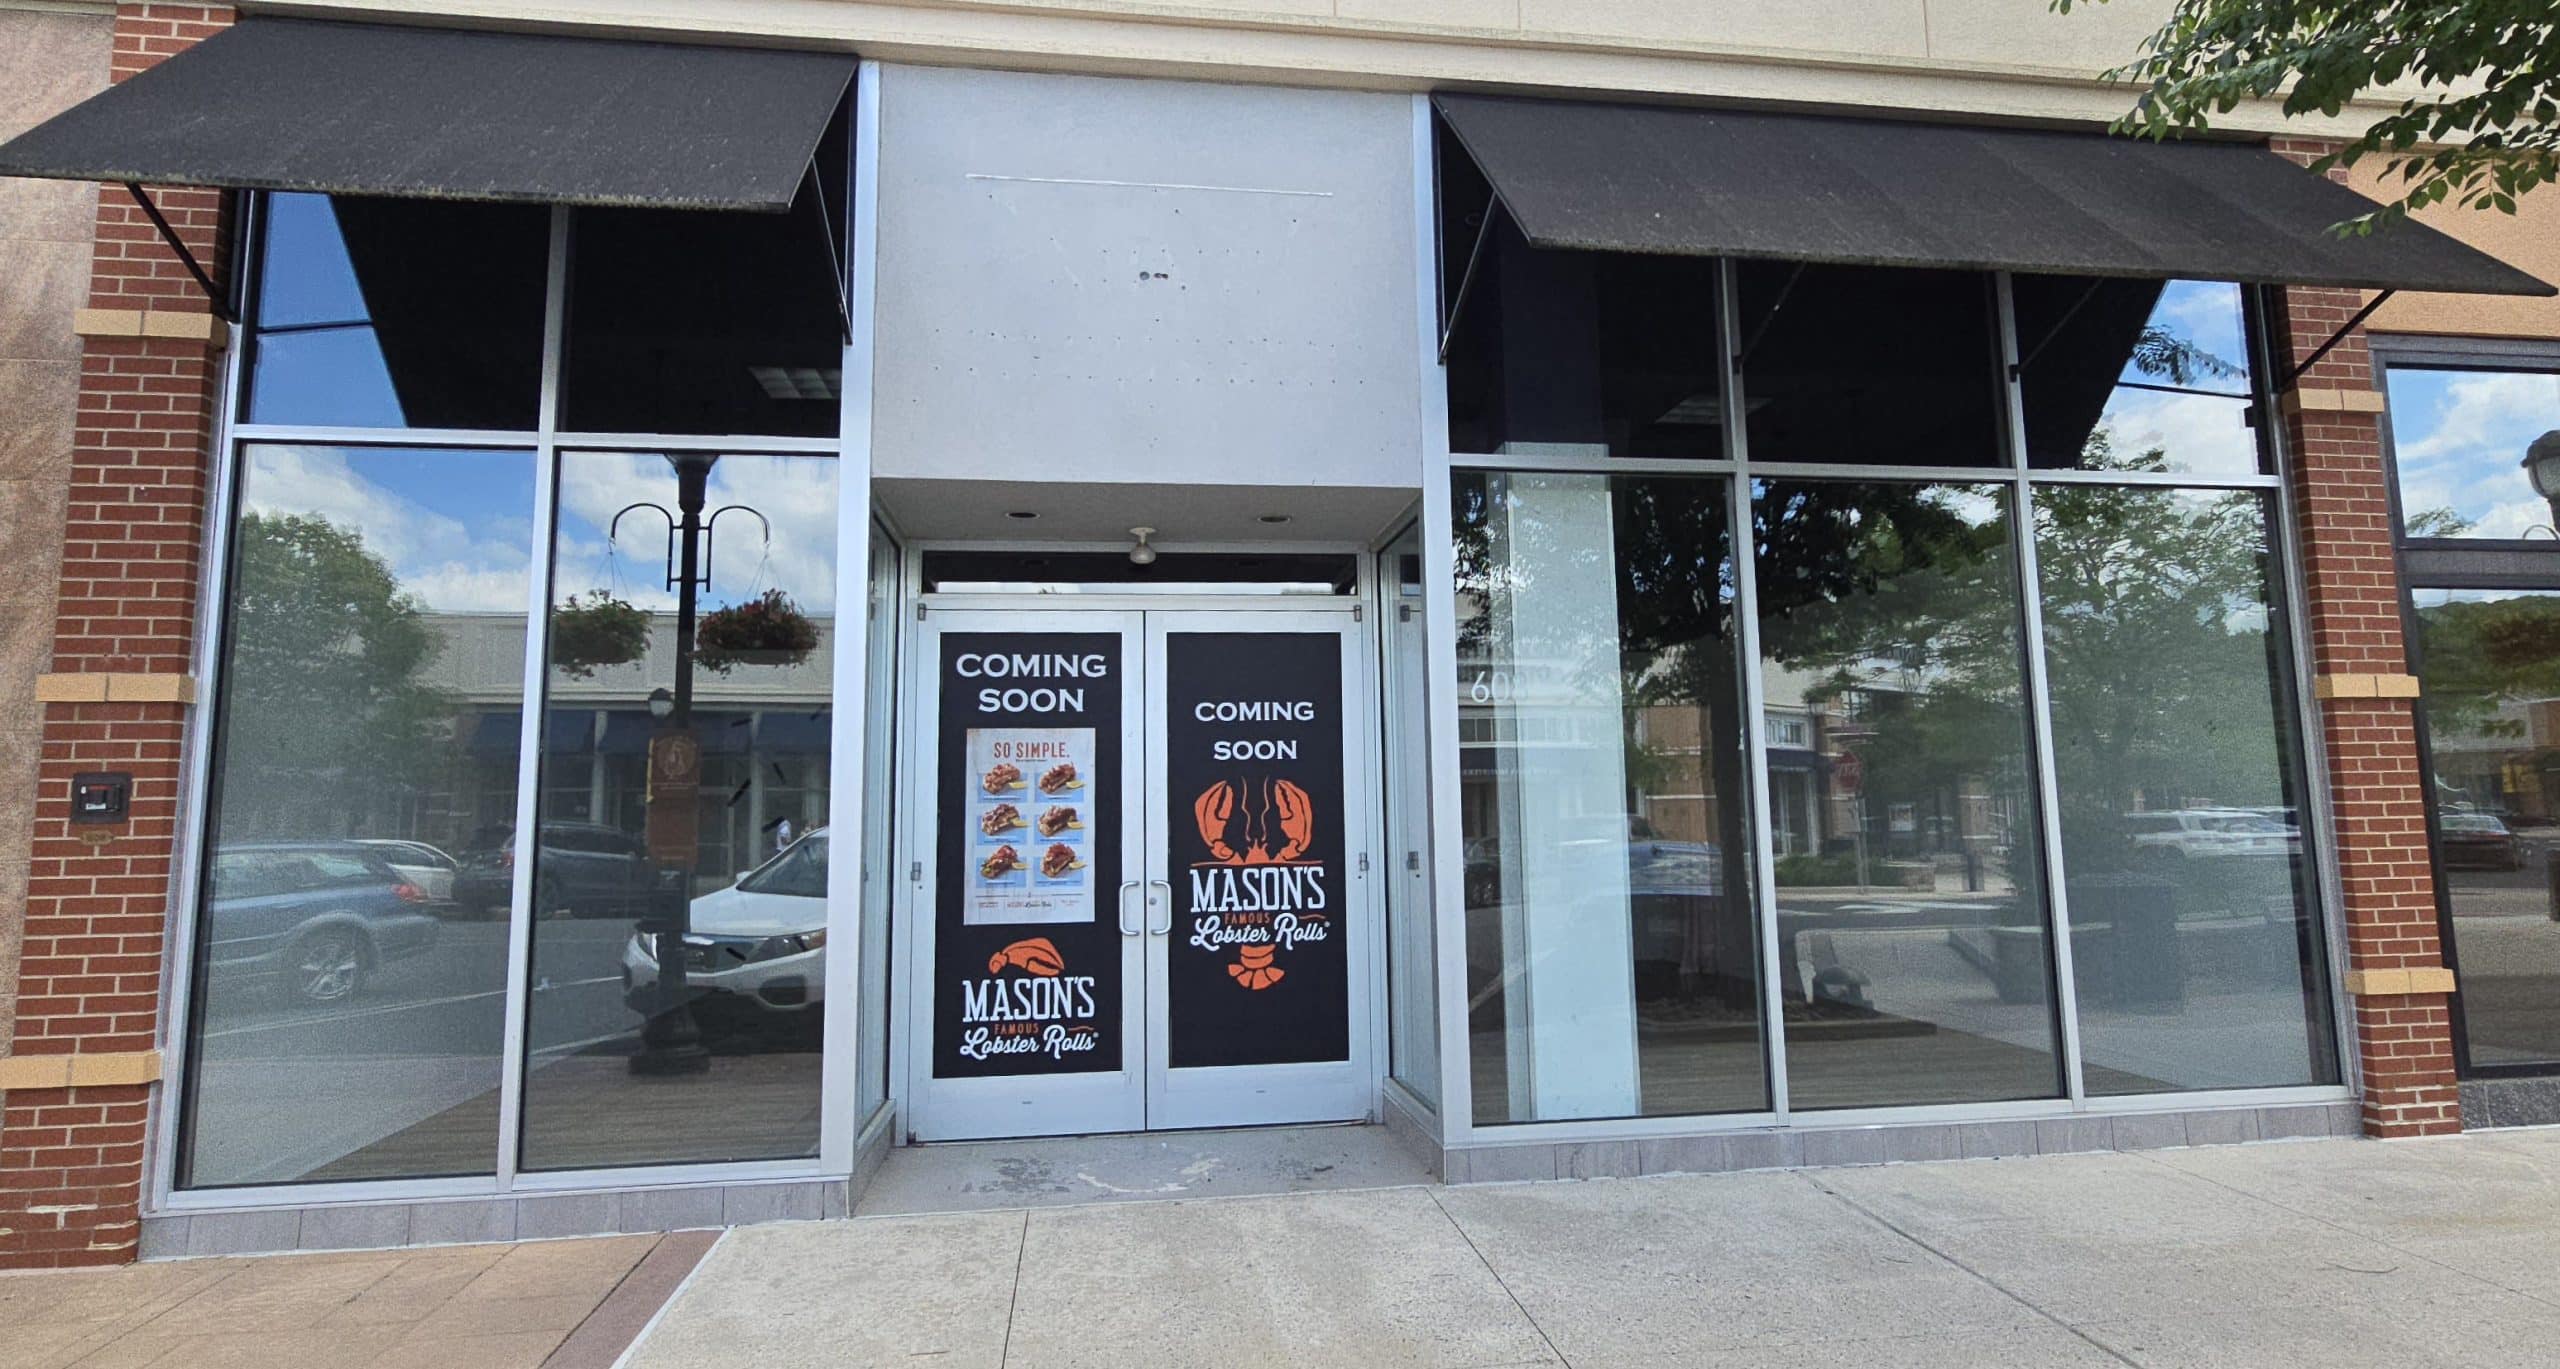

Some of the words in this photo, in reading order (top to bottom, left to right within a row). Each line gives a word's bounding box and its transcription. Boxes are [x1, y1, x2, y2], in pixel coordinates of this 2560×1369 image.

[956, 653, 1107, 678] COMING
[978, 688, 1084, 713] SOON
[1194, 701, 1315, 722] COMING
[994, 742, 1011, 759] SO
[1016, 742, 1070, 758] SIMPLE.
[1213, 740, 1298, 760] SOON
[1189, 866, 1326, 913] MASON'S
[1224, 912, 1271, 925] FAMOUS
[1190, 915, 1271, 951] Lobster
[962, 976, 1096, 1023] MASON'S
[994, 1023, 1040, 1035] FAMOUS
[959, 1027, 1041, 1061] Lobster
